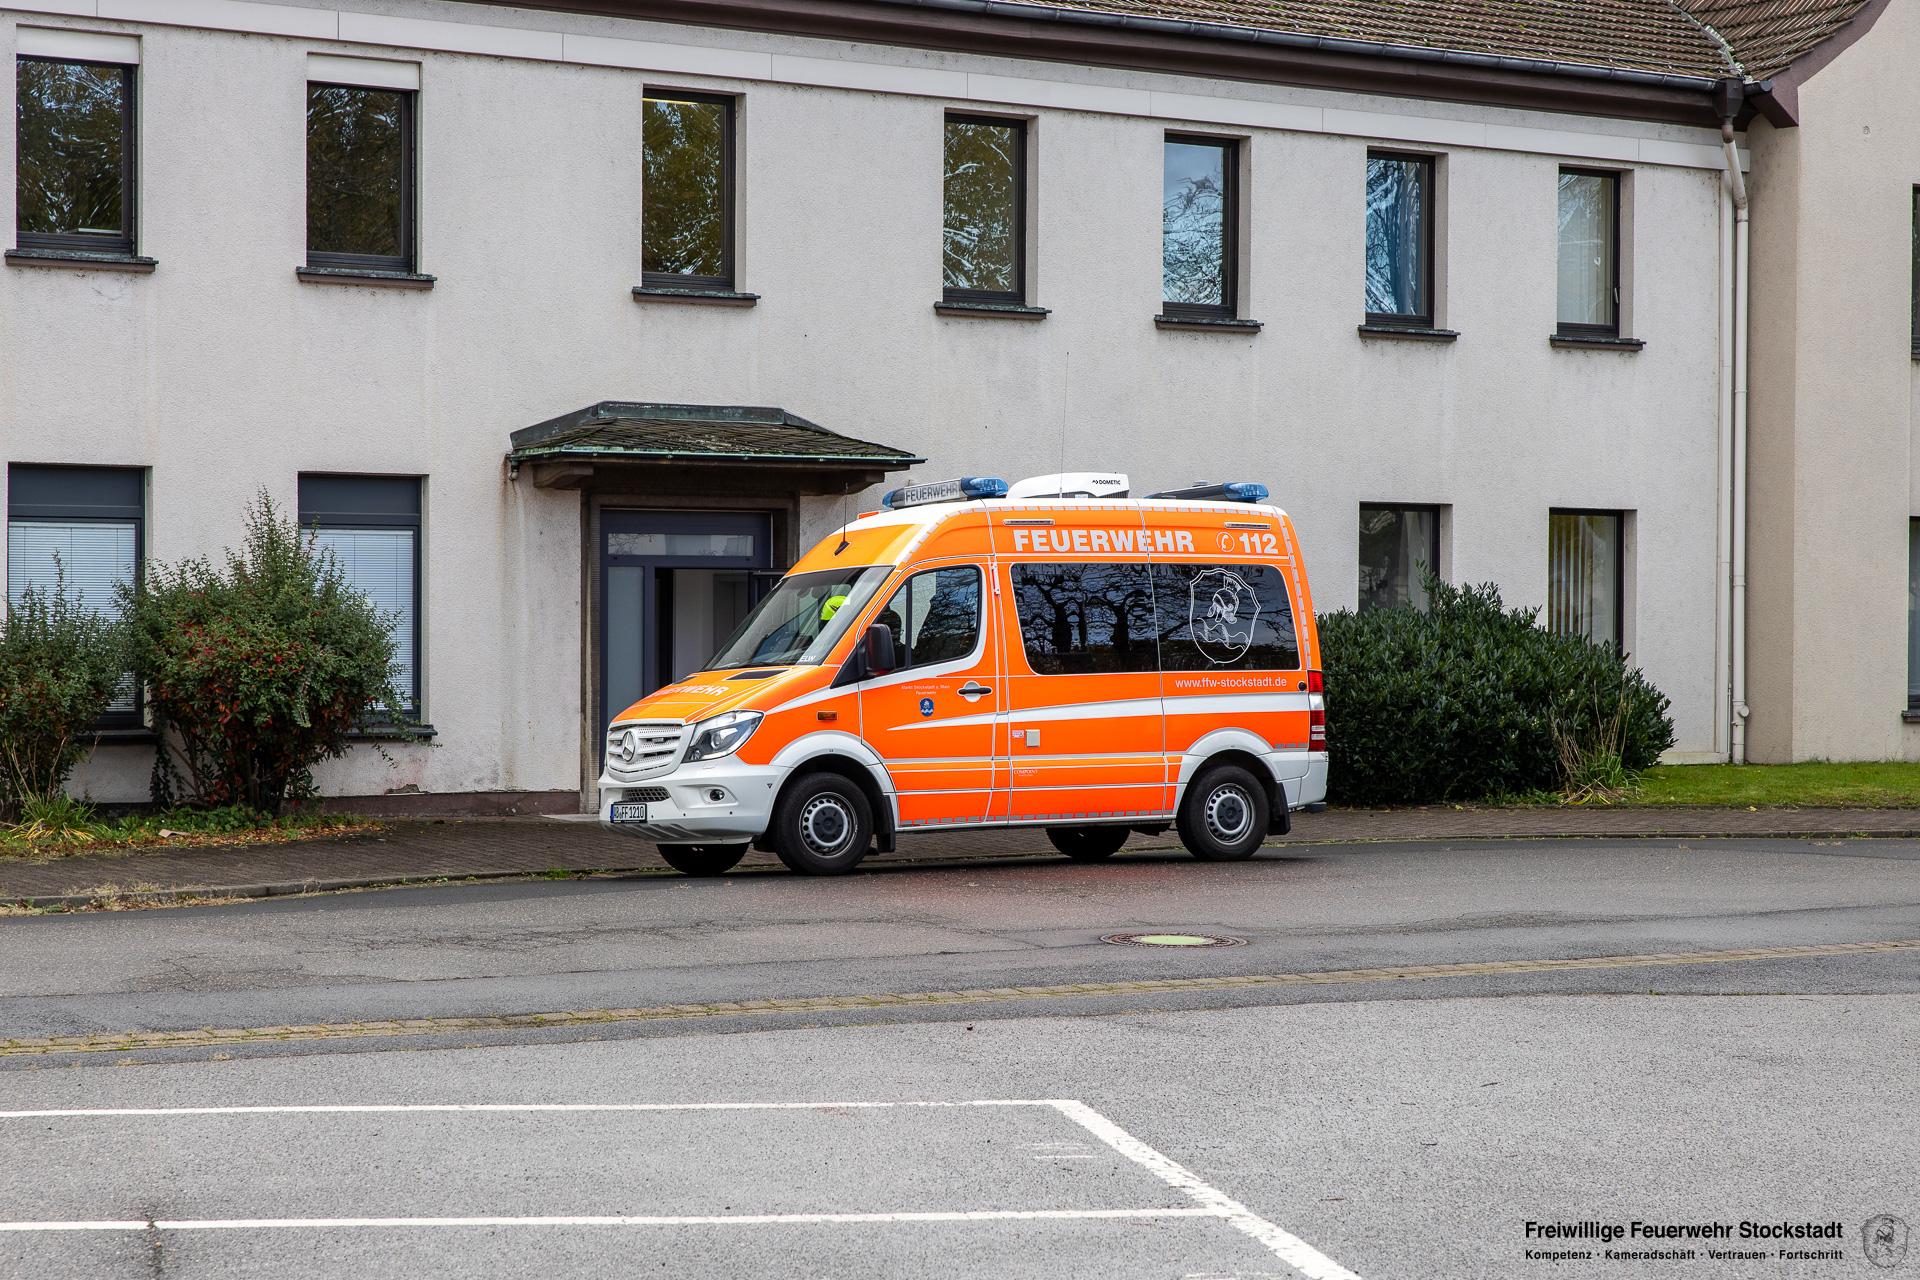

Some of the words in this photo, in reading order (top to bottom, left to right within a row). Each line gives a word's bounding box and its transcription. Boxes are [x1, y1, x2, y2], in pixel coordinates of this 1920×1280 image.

[905, 484, 958, 502] FEUERWEHR
[1012, 529, 1195, 553] FEUERWEHR
[1238, 532, 1279, 554] 112
[1175, 676, 1287, 688] www.ffw-stockstadt.de
[629, 806, 644, 818] 1210
